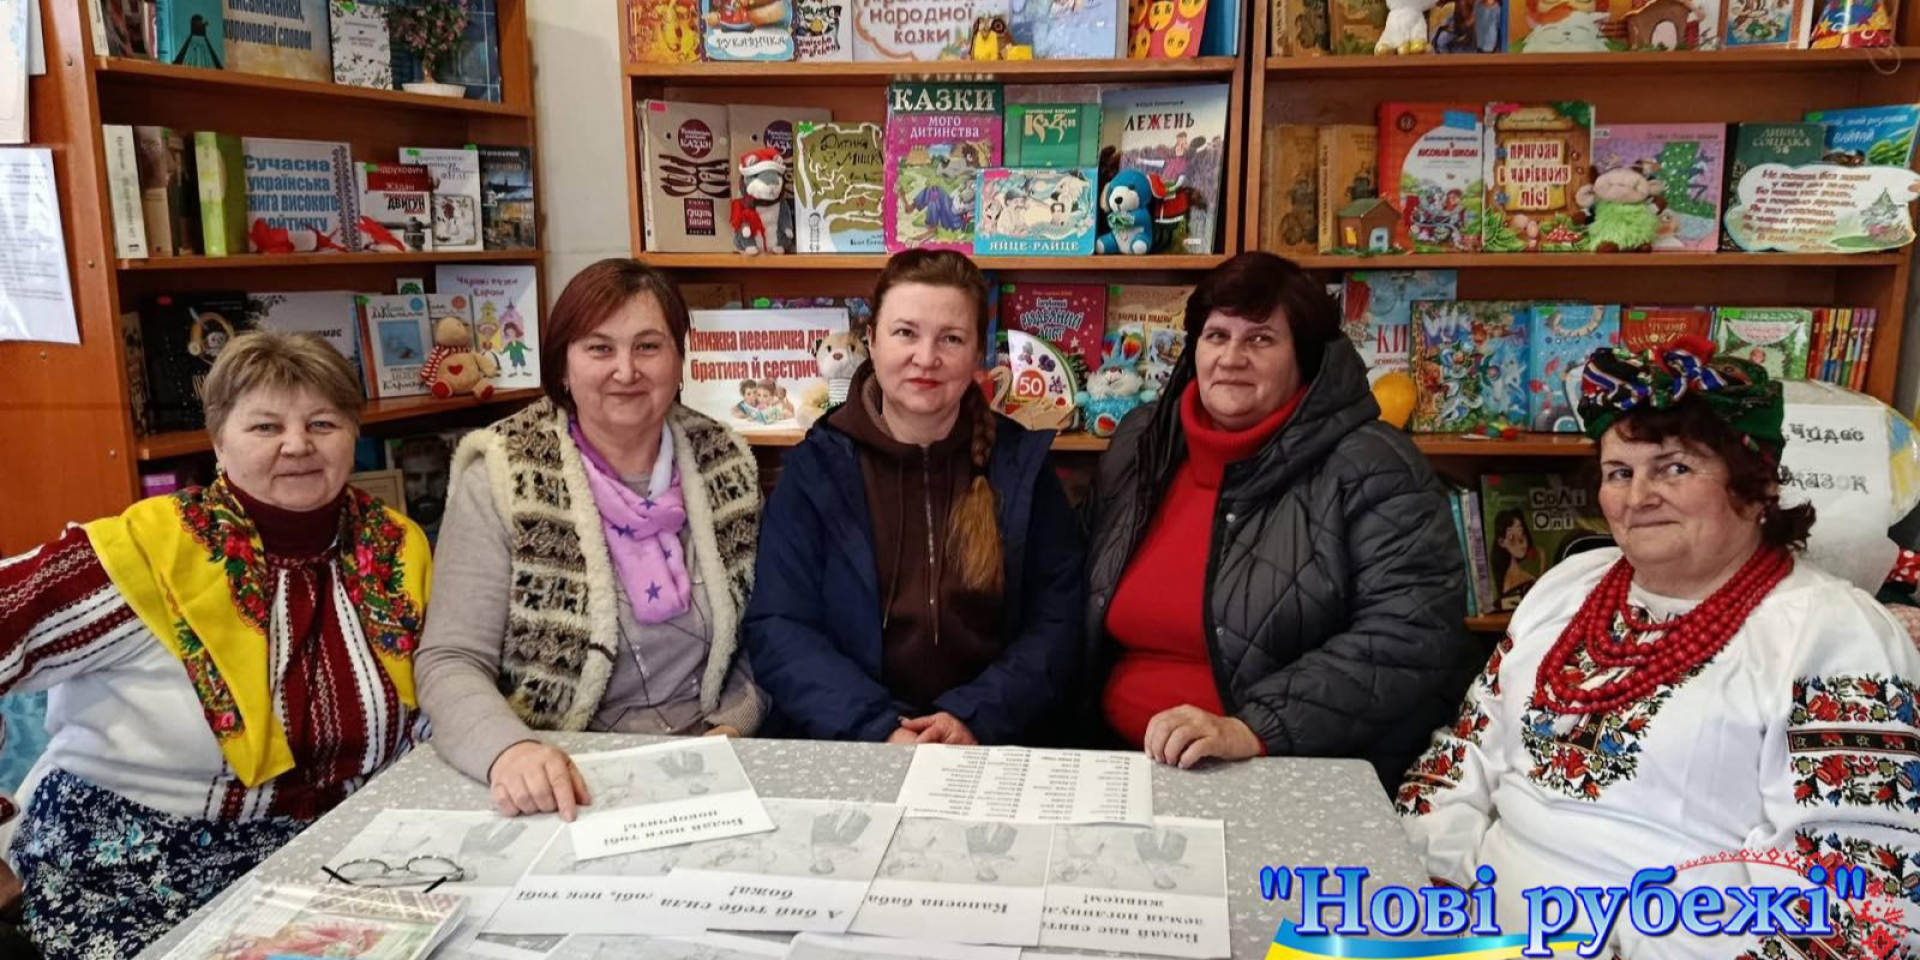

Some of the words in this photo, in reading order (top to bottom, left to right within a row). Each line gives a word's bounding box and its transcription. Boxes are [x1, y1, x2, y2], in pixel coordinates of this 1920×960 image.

[869, 3, 973, 29] народної
[894, 28, 950, 44] казки
[893, 88, 996, 112] КАЗКИ
[1124, 112, 1195, 132] ЛЕЖЕНЬ
[1510, 143, 1559, 159] ПРИГОДИ
[243, 155, 331, 171] Сучасна
[1511, 164, 1568, 182] ЧАРІВНОМУ
[248, 173, 331, 192] українська
[247, 194, 279, 212] нига
[281, 195, 339, 212] високого
[387, 197, 425, 210] ДВИГУН
[1520, 187, 1548, 206] ЛІСІ
[690, 328, 737, 352] Книжка
[739, 329, 806, 352] невеличка
[690, 359, 749, 382] братика
[751, 355, 761, 379] й
[763, 359, 821, 380] сестрич
[1018, 376, 1043, 395] 50
[728, 885, 793, 900] божа!
[660, 898, 712, 911] сила
[868, 894, 914, 908] баба
[719, 903, 768, 917] тебе
[773, 906, 818, 920] бий
[827, 910, 844, 919] А
[1145, 913, 1204, 926] земля
[1096, 925, 1131, 936] вас
[1138, 928, 1200, 944] Бодай
